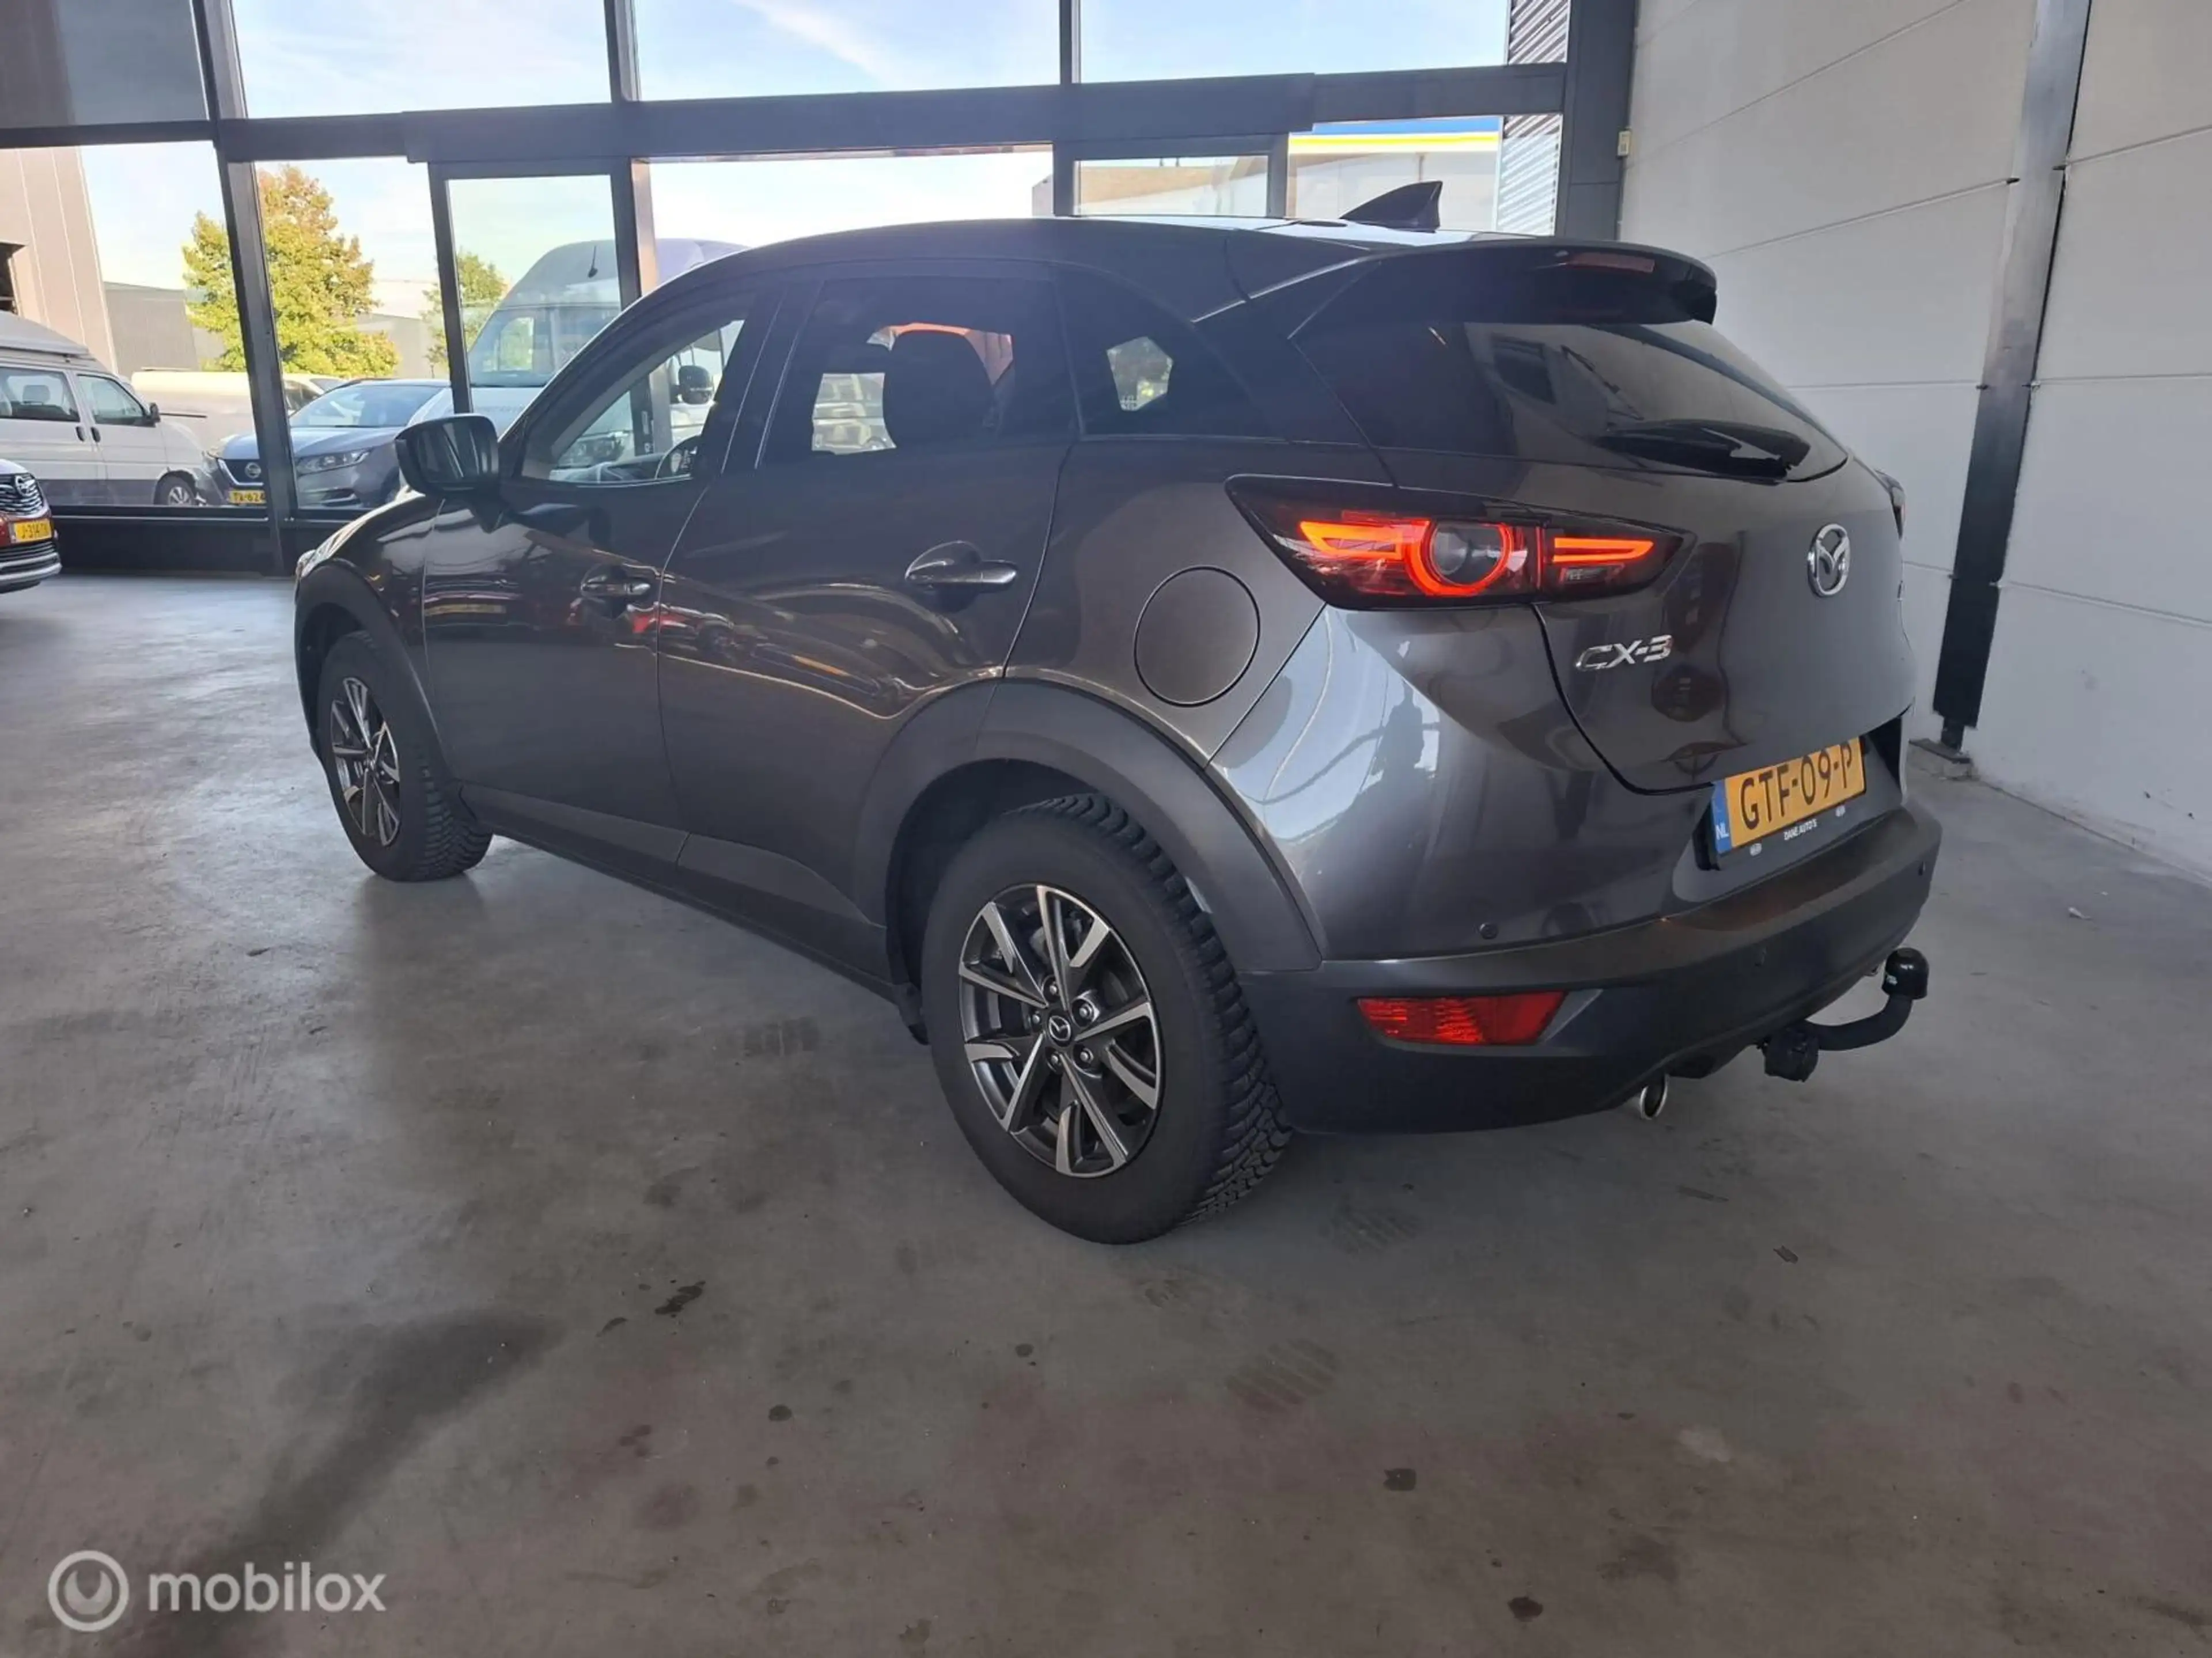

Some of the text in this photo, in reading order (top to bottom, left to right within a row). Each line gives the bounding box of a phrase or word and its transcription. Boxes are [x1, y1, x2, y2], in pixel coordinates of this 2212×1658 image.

[1575, 634, 1673, 671] CX-3
[1740, 742, 1852, 830] GTF-09-P
[1715, 822, 1730, 840] NL
